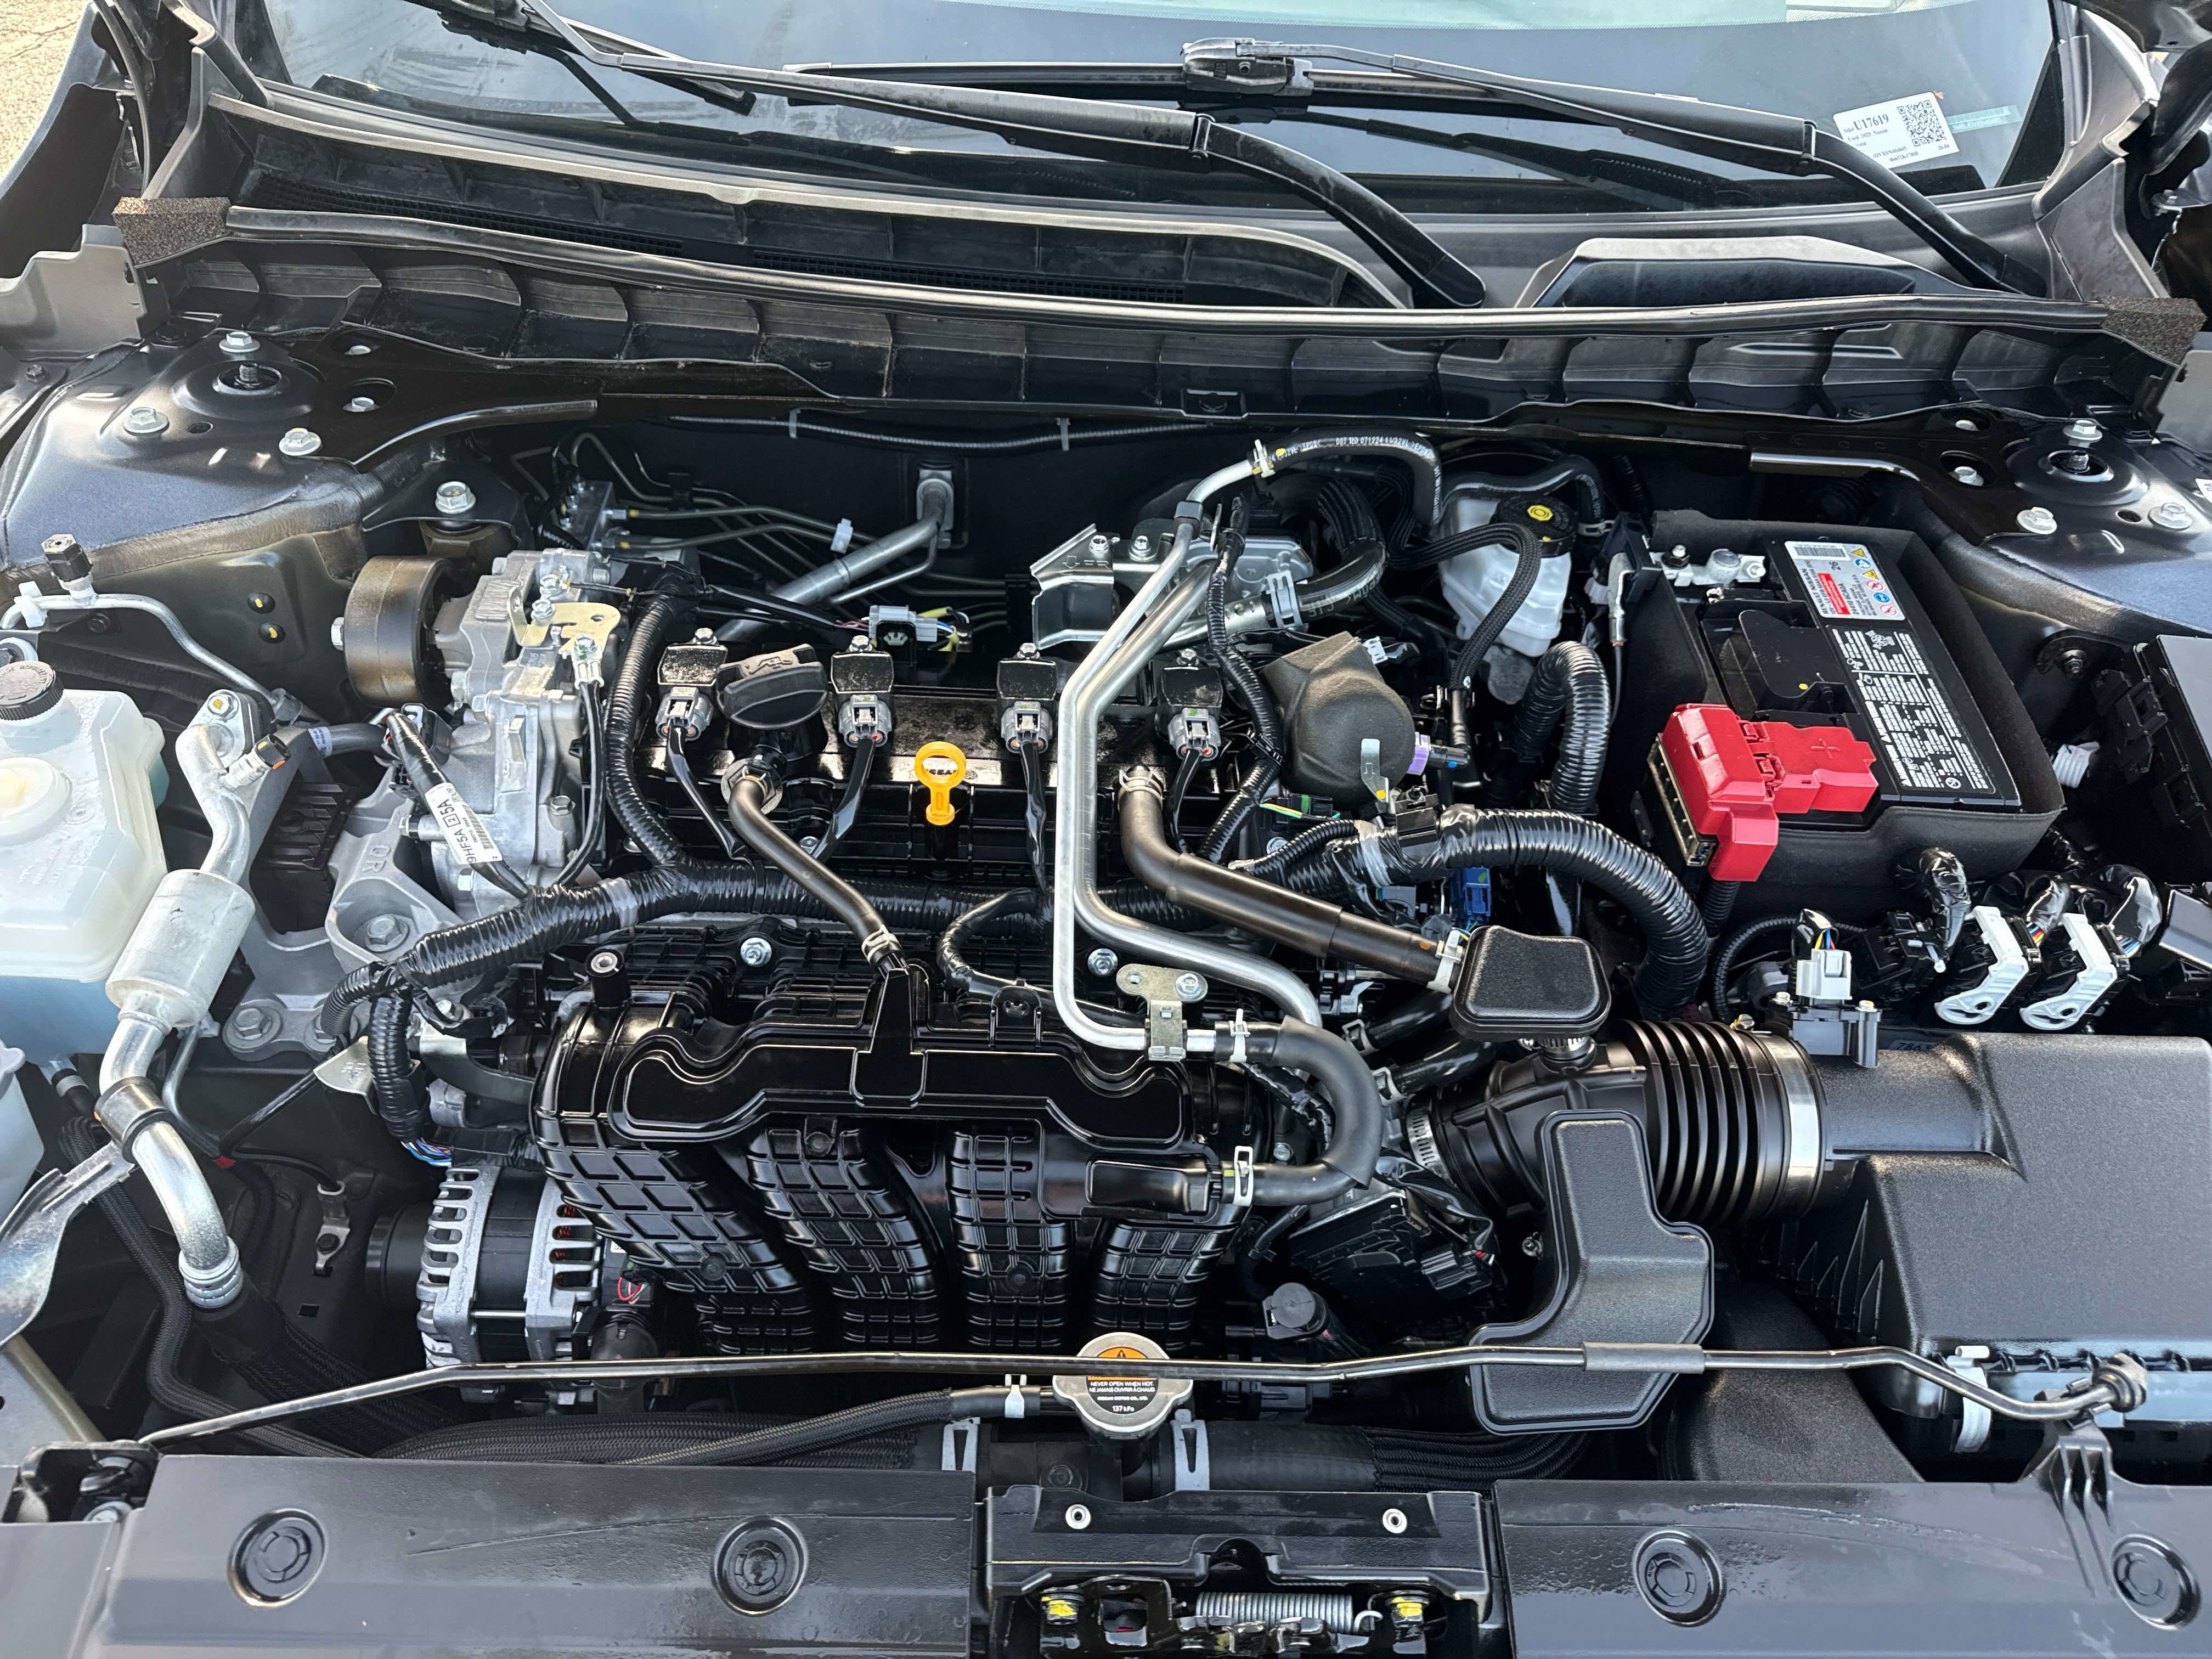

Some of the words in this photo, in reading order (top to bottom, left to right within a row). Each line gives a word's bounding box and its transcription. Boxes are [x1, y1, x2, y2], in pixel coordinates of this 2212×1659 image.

[1853, 114, 1889, 131] U17619
[1829, 561, 1841, 571] 26
[1800, 568, 1816, 590] NISSAN
[1813, 592, 1828, 614] RENAULT
[437, 798, 455, 815] 5A
[454, 828, 477, 864] 9HF5A
